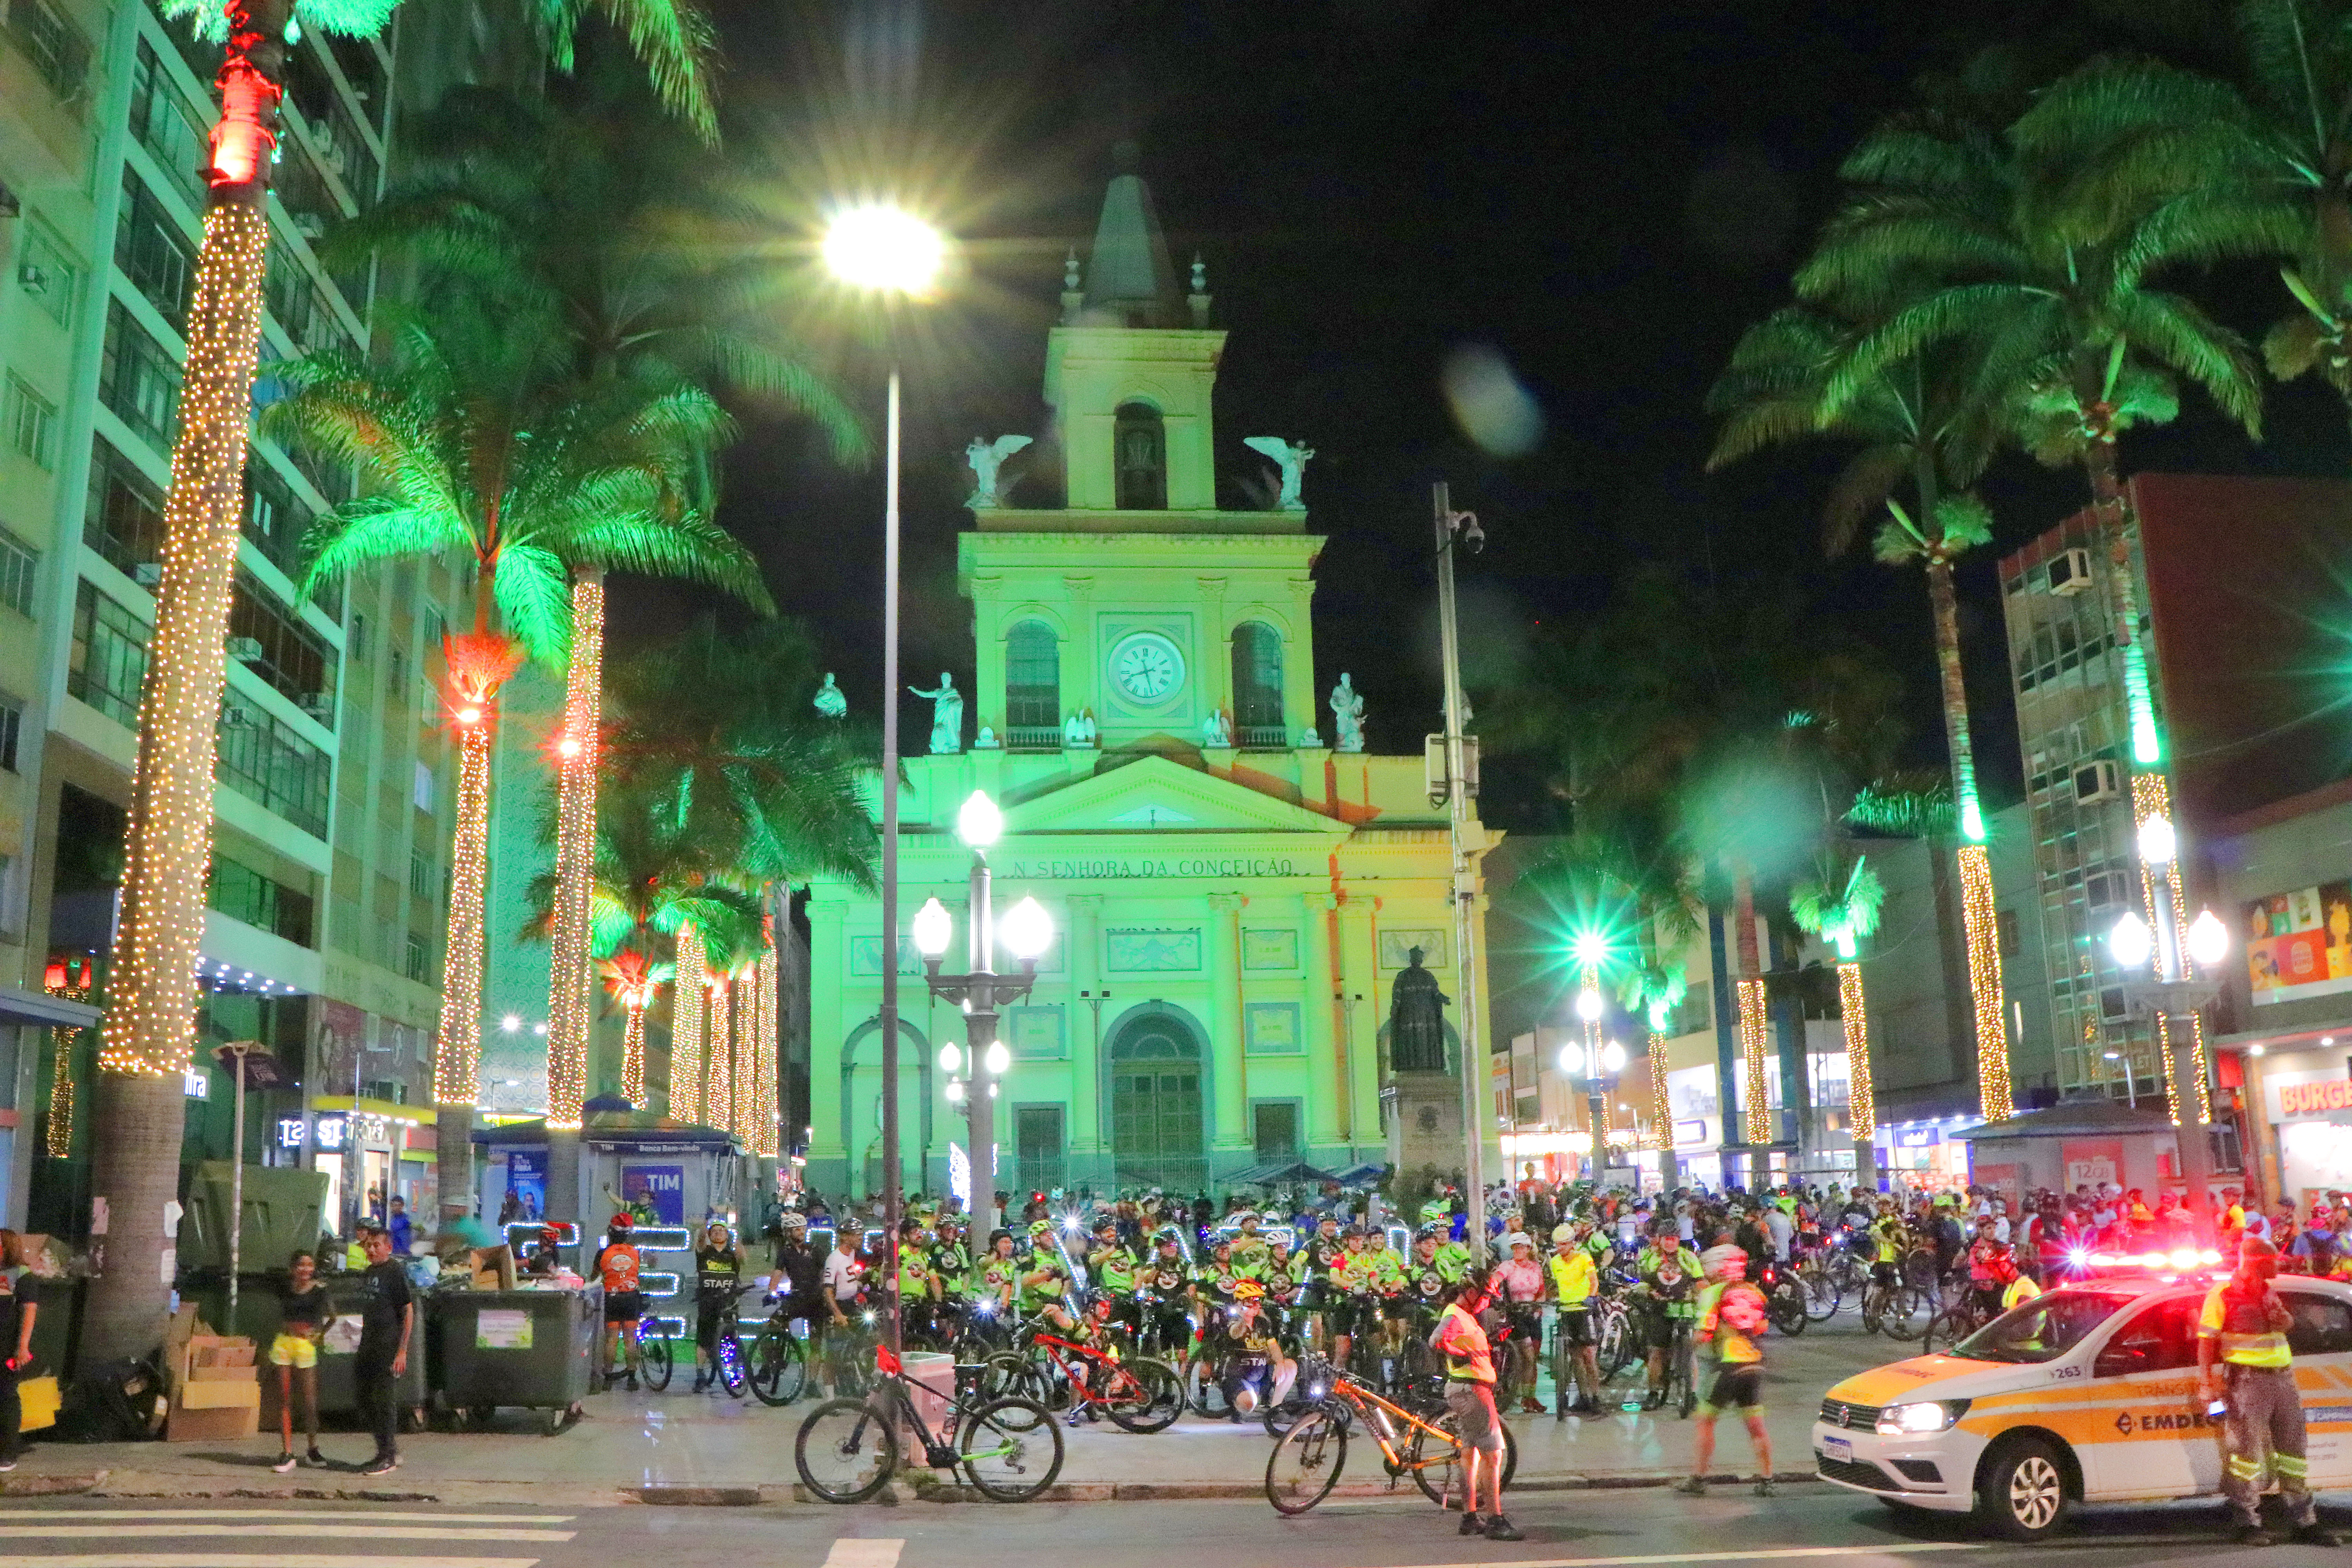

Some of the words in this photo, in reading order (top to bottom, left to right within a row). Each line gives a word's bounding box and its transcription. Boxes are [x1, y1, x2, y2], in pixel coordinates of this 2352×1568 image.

[1038, 861, 1131, 877] SENHORA
[1142, 860, 1167, 875] DA
[647, 1174, 679, 1191] TIM
[704, 1279, 733, 1288] STAFF
[2056, 1366, 2081, 1379] 263
